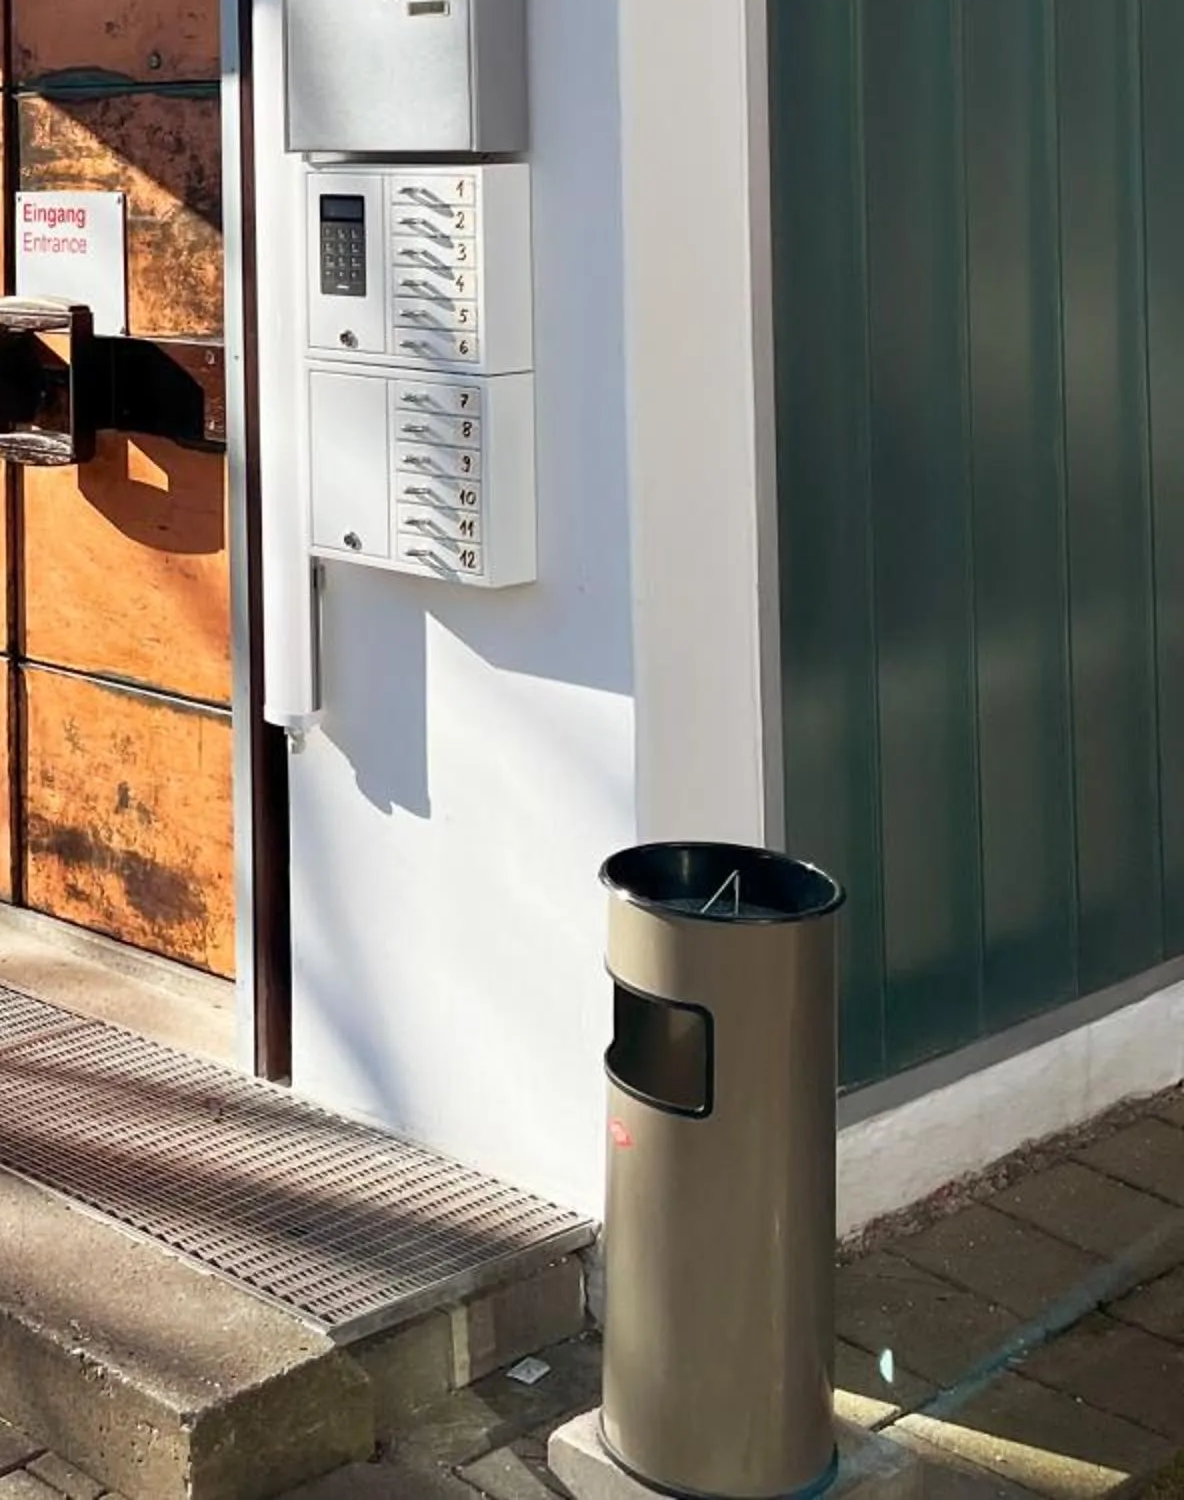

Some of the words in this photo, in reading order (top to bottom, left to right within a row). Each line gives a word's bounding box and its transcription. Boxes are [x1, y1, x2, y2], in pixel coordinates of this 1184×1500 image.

[456, 180, 464, 197] 1
[23, 203, 86, 228] Eingang
[455, 211, 465, 229] 2
[23, 232, 87, 254] Entrance
[456, 243, 467, 261] 3
[455, 275, 464, 293] 4
[459, 309, 468, 324] 5
[459, 340, 468, 355] 6
[460, 394, 469, 408] 7
[462, 421, 472, 438] 8
[461, 455, 471, 473] 9
[459, 489, 476, 505] 10
[459, 520, 473, 537] 11
[459, 550, 476, 569] 12
